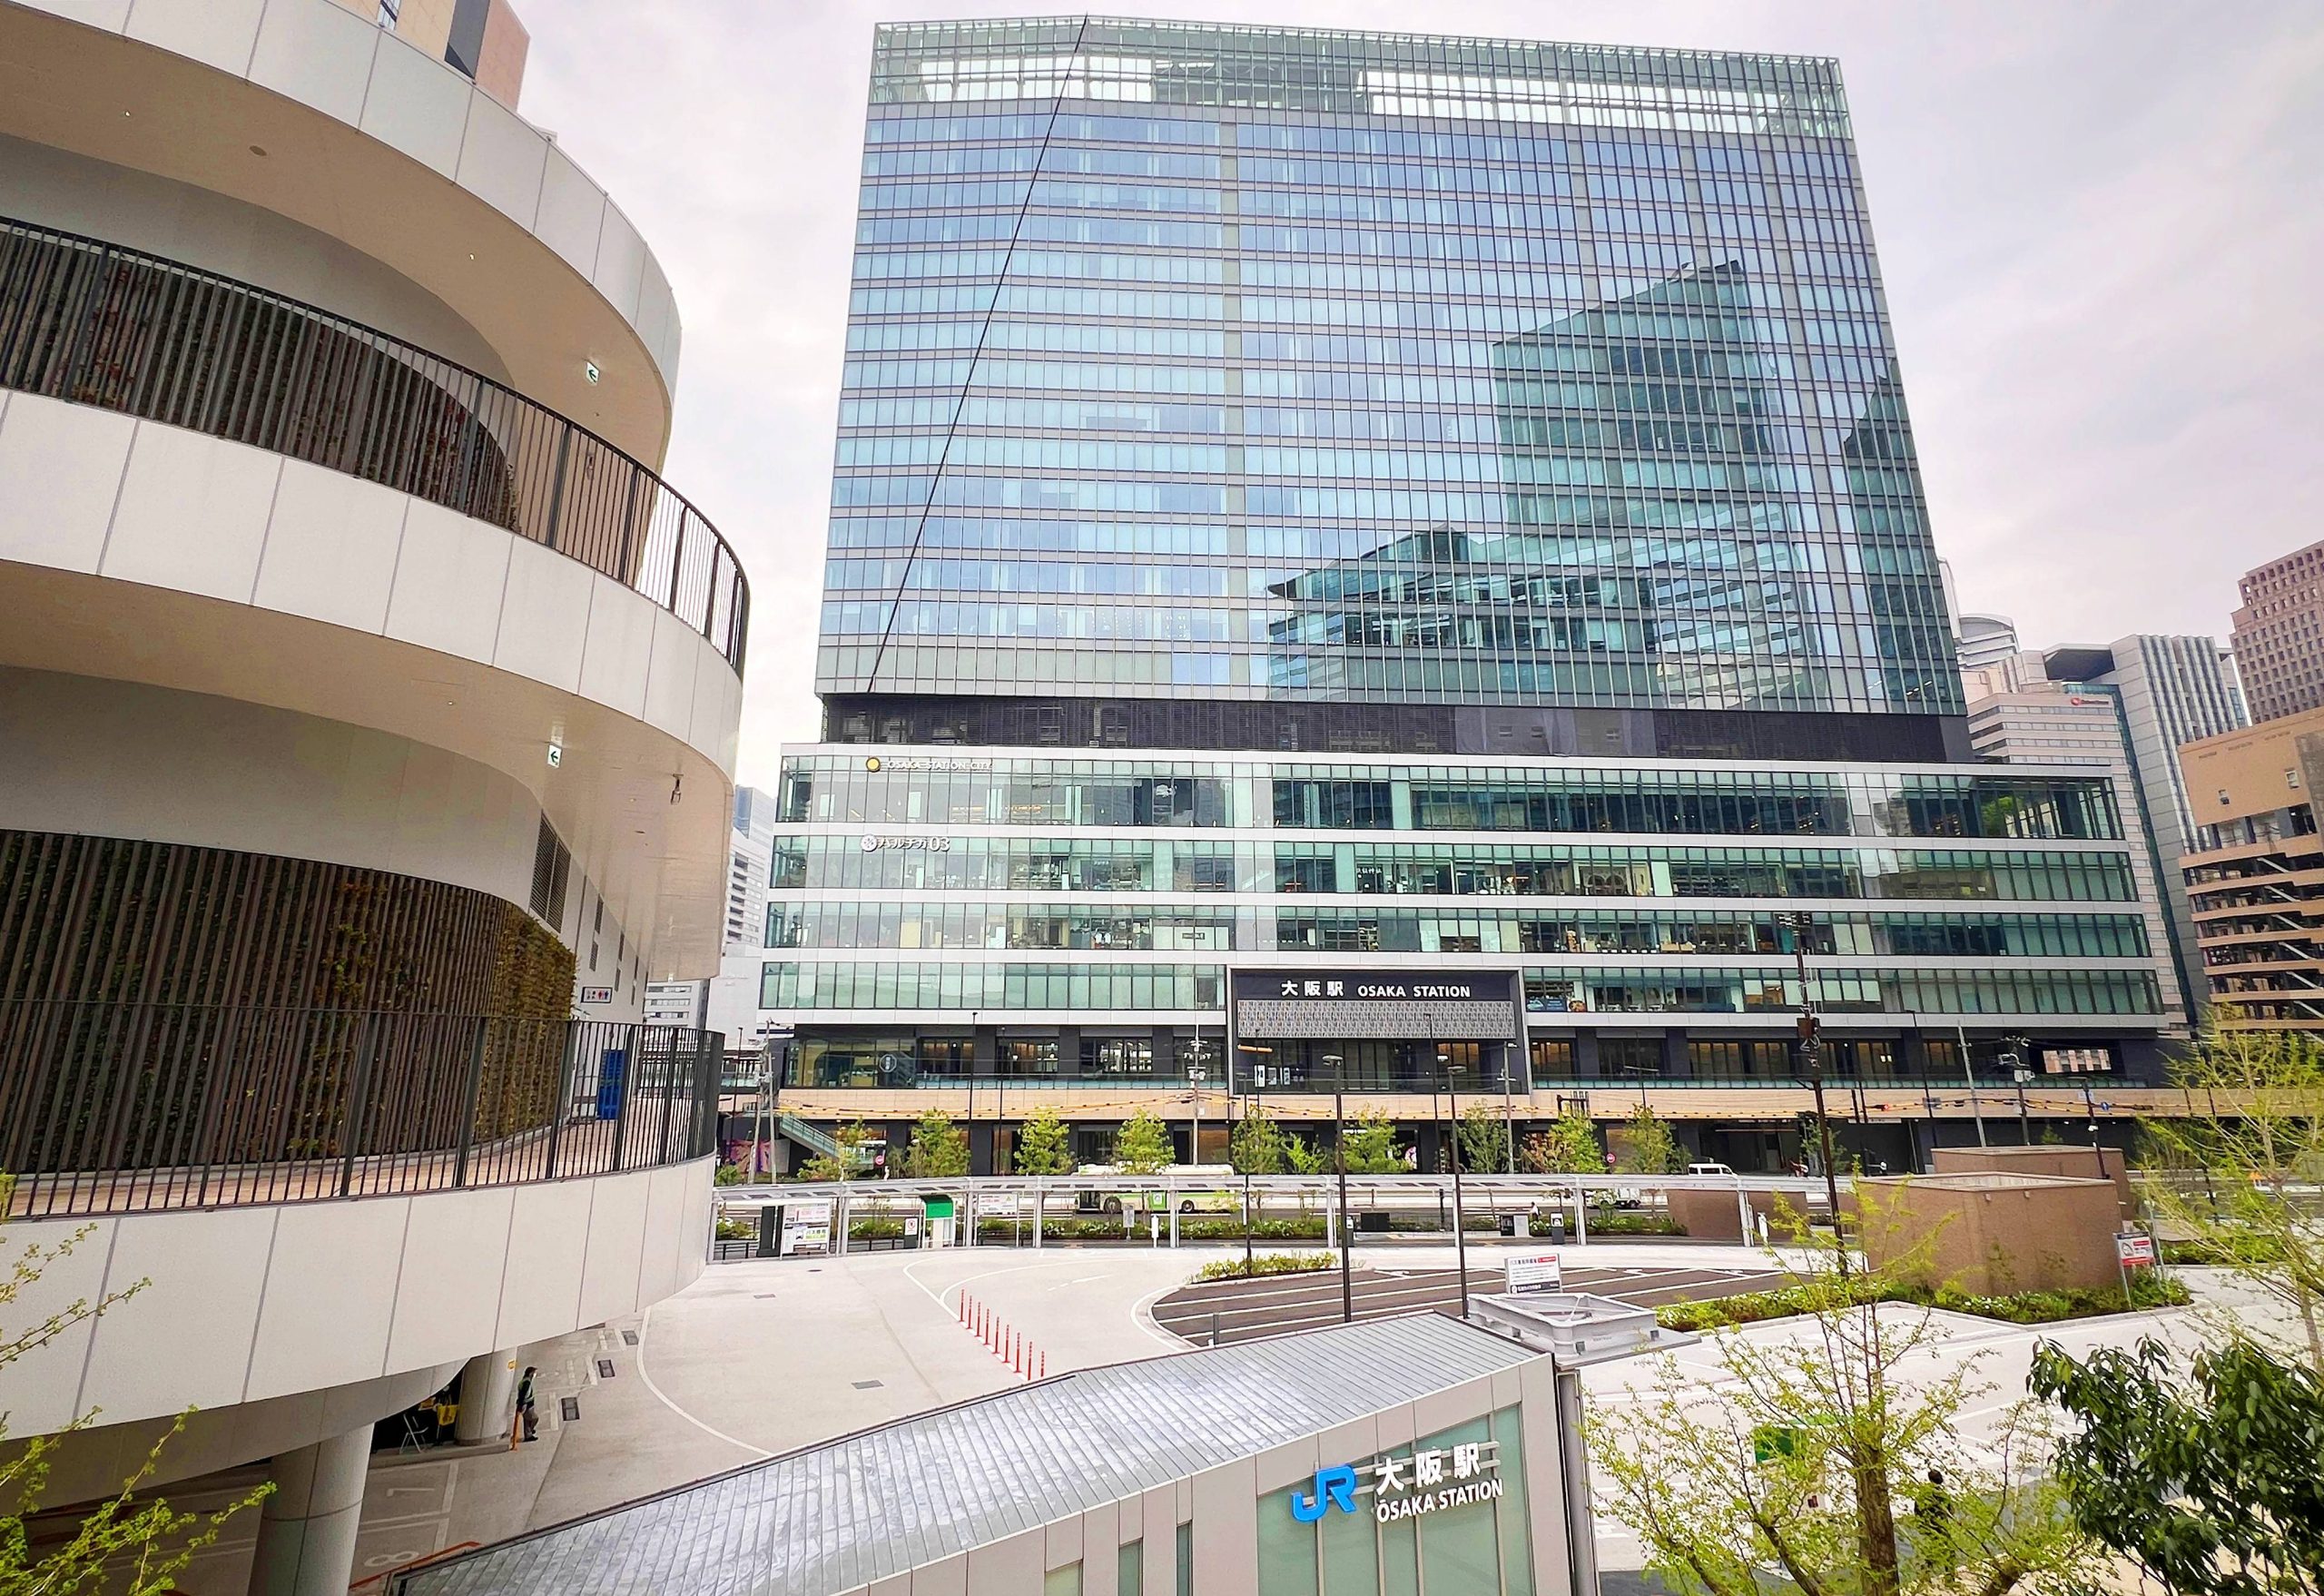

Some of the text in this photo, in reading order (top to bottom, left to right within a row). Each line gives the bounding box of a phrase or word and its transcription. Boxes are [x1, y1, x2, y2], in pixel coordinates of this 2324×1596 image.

[887, 760, 920, 771] OSAKA
[927, 761, 965, 771] STATION
[1281, 980, 1472, 998] 大阪駅 OSAKA STATION
[1374, 1442, 1482, 1496] 大阪駅
[1292, 1465, 1357, 1522] JR
[1438, 1478, 1504, 1511] STATION
